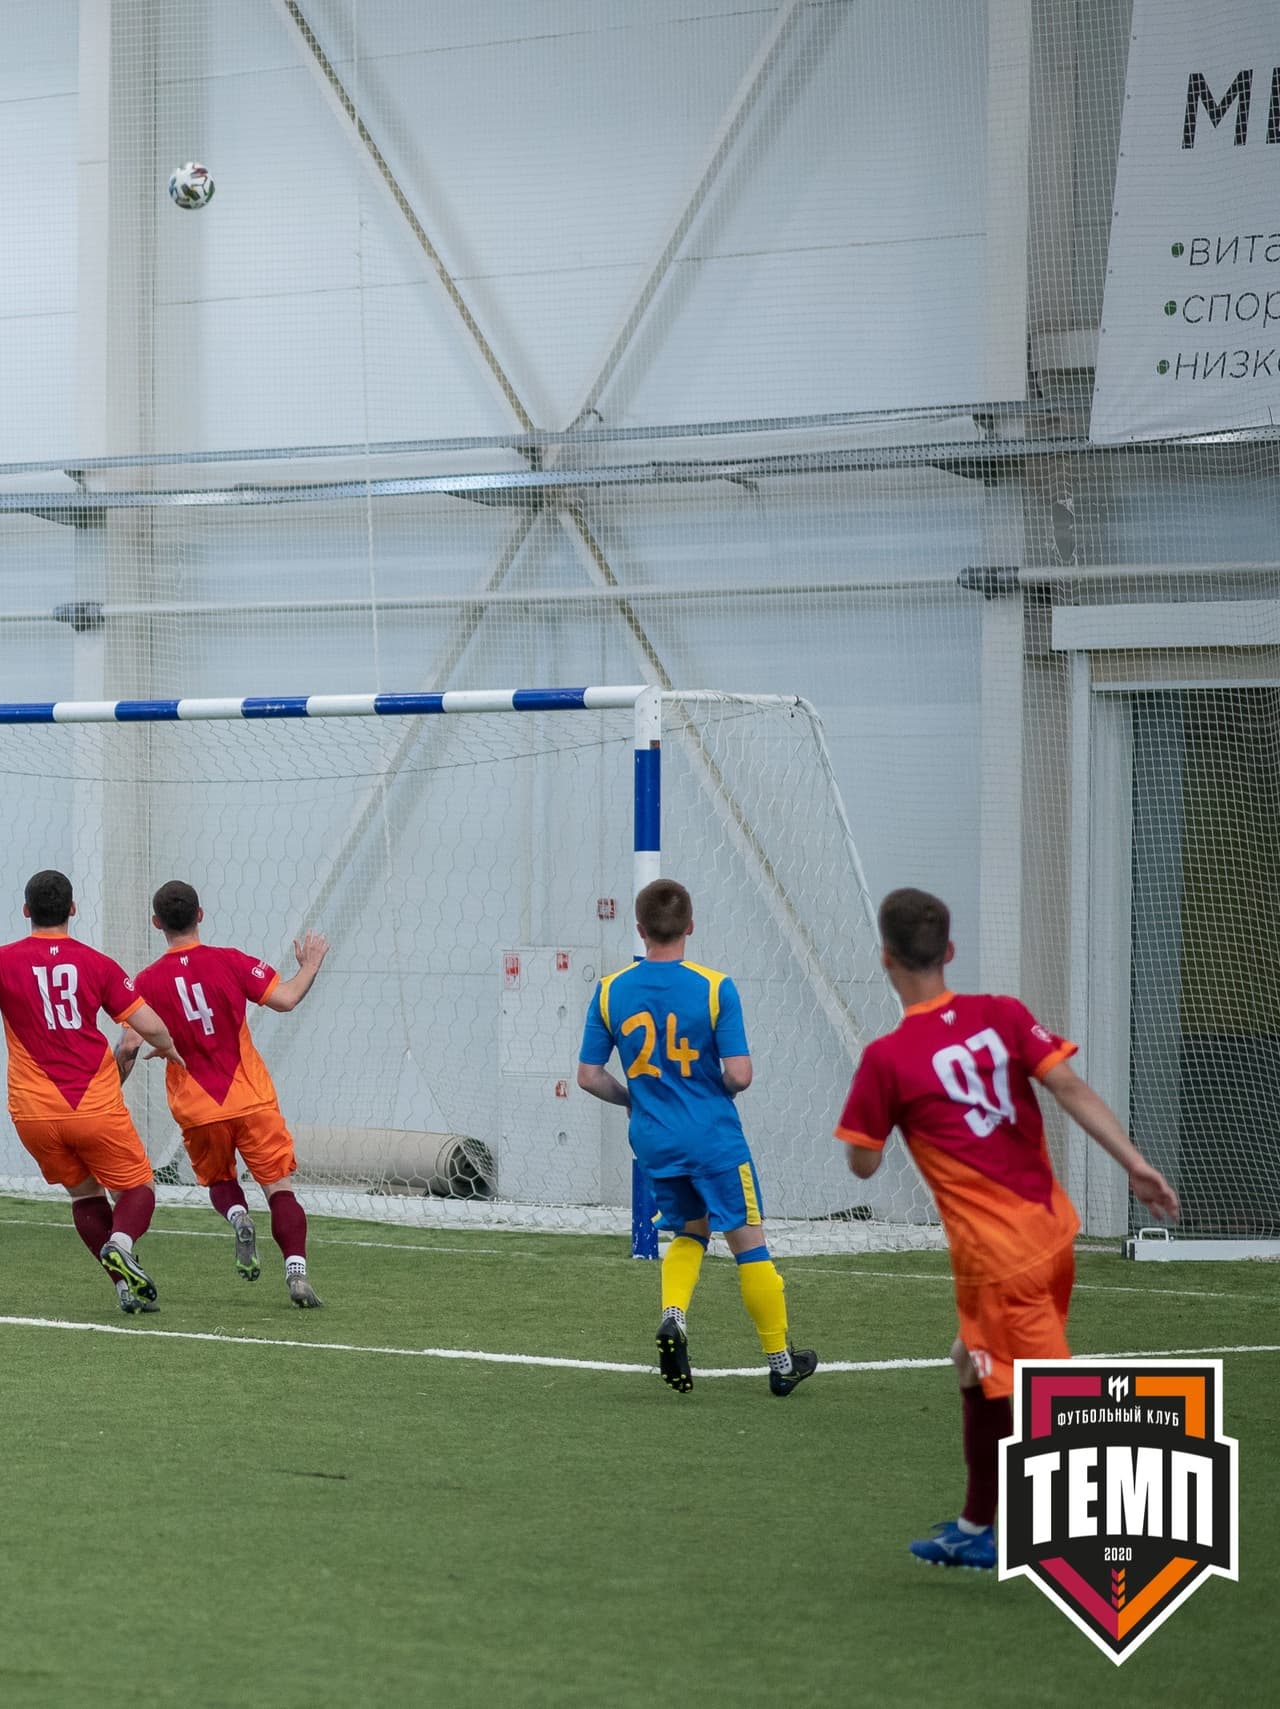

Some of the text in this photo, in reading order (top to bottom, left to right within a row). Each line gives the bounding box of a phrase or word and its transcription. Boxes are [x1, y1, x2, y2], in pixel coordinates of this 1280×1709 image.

[1175, 349, 1280, 380] низк
[32, 964, 83, 1030] 13
[175, 976, 214, 1036] 4
[621, 1011, 700, 1079] 24
[932, 1027, 1016, 1138] 97
